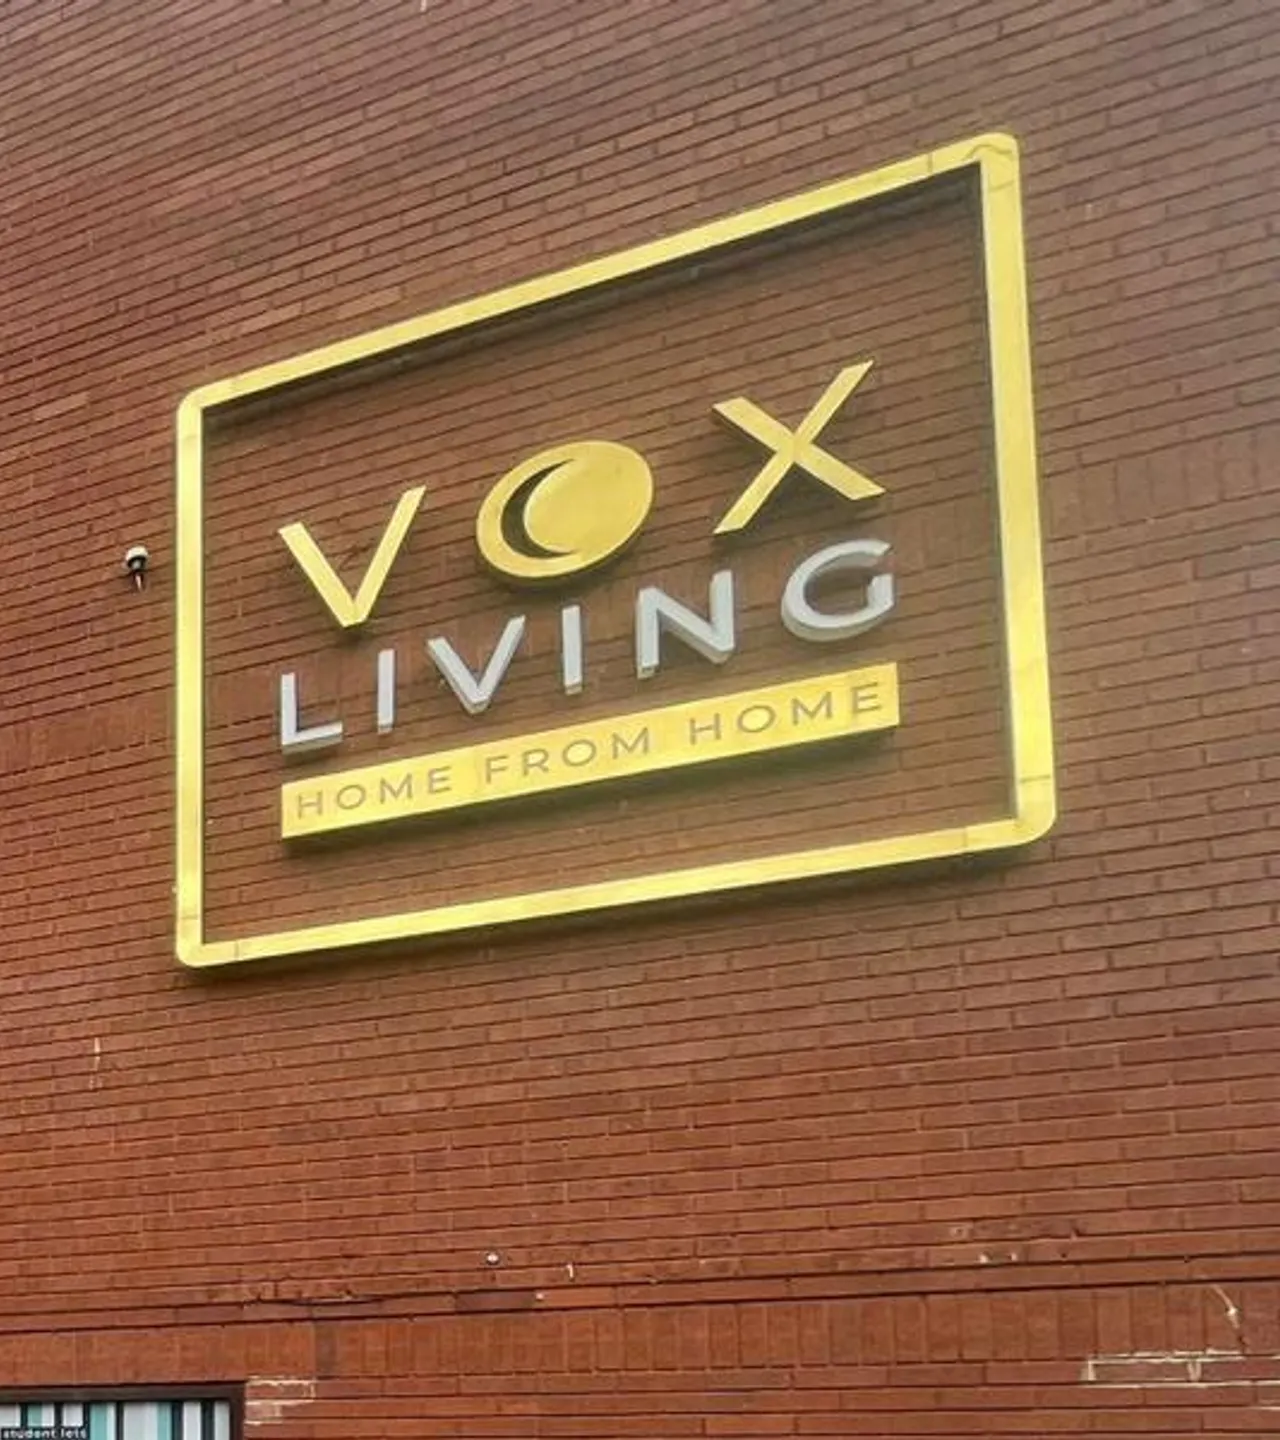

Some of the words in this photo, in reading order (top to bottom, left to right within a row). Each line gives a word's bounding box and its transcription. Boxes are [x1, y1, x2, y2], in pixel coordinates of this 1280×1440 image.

[278, 359, 887, 628] VOX
[280, 538, 896, 754] LIVING
[295, 764, 454, 821] HOME
[484, 727, 652, 786] FROM
[689, 679, 887, 748] HOME
[2, 1427, 56, 1440] student
[60, 1427, 87, 1440] lets
